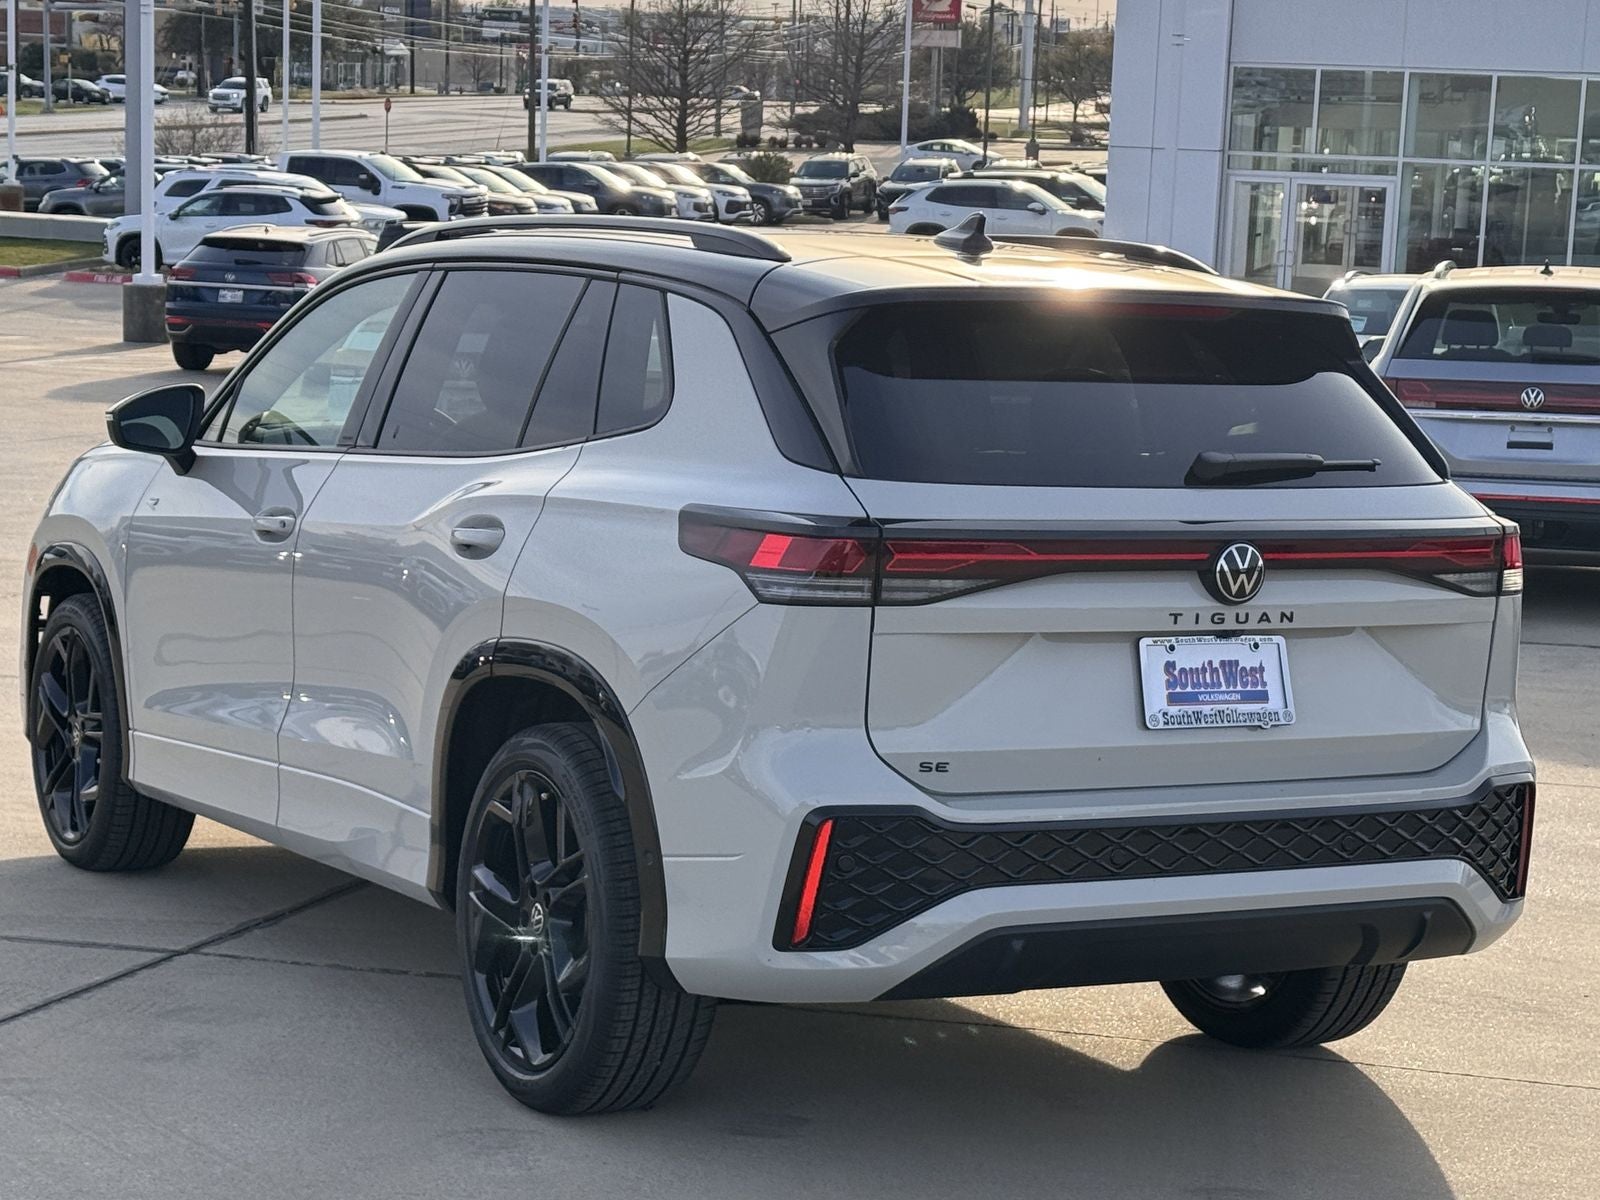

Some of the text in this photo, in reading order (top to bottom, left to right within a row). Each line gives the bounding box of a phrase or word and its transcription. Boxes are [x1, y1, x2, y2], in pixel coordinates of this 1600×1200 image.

[1215, 543, 1265, 602] VW
[1168, 611, 1295, 625] TIGUAN
[1163, 659, 1268, 691] SouthWest
[1197, 693, 1241, 702] VOLKSWAGEN
[1162, 707, 1280, 727] SouthWestVolkswagen
[918, 761, 950, 773] SE
